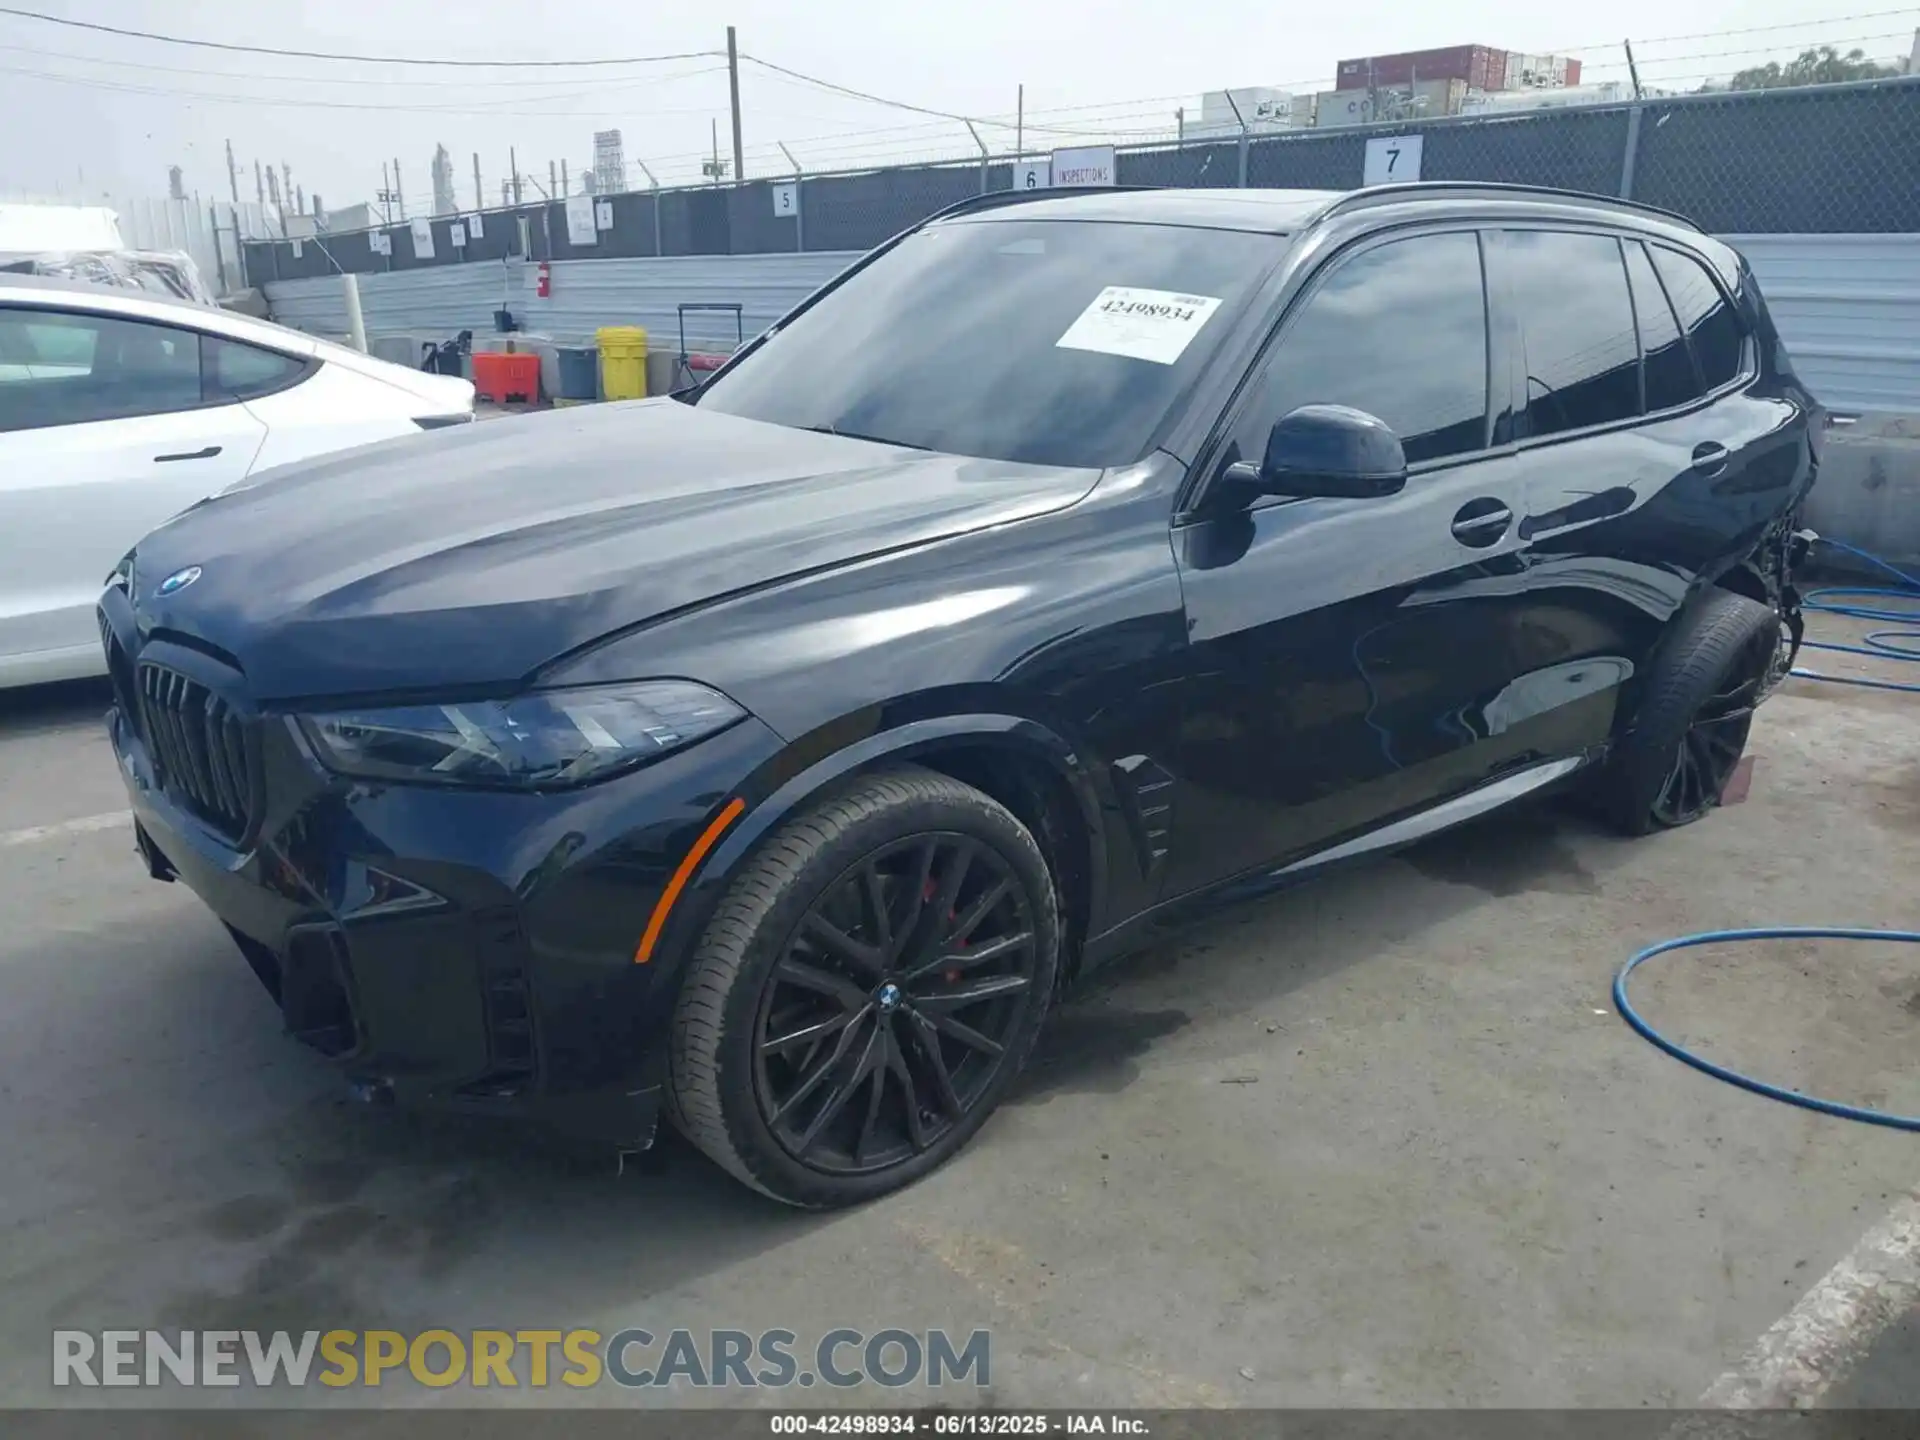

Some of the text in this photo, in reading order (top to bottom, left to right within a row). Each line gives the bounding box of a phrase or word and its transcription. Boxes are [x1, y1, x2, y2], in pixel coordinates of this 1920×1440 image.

[1386, 149, 1401, 173] 7
[1026, 171, 1037, 188] 6
[1059, 167, 1108, 184] INSPECTIONS
[783, 192, 790, 208] 5
[1100, 300, 1196, 322] 42498934
